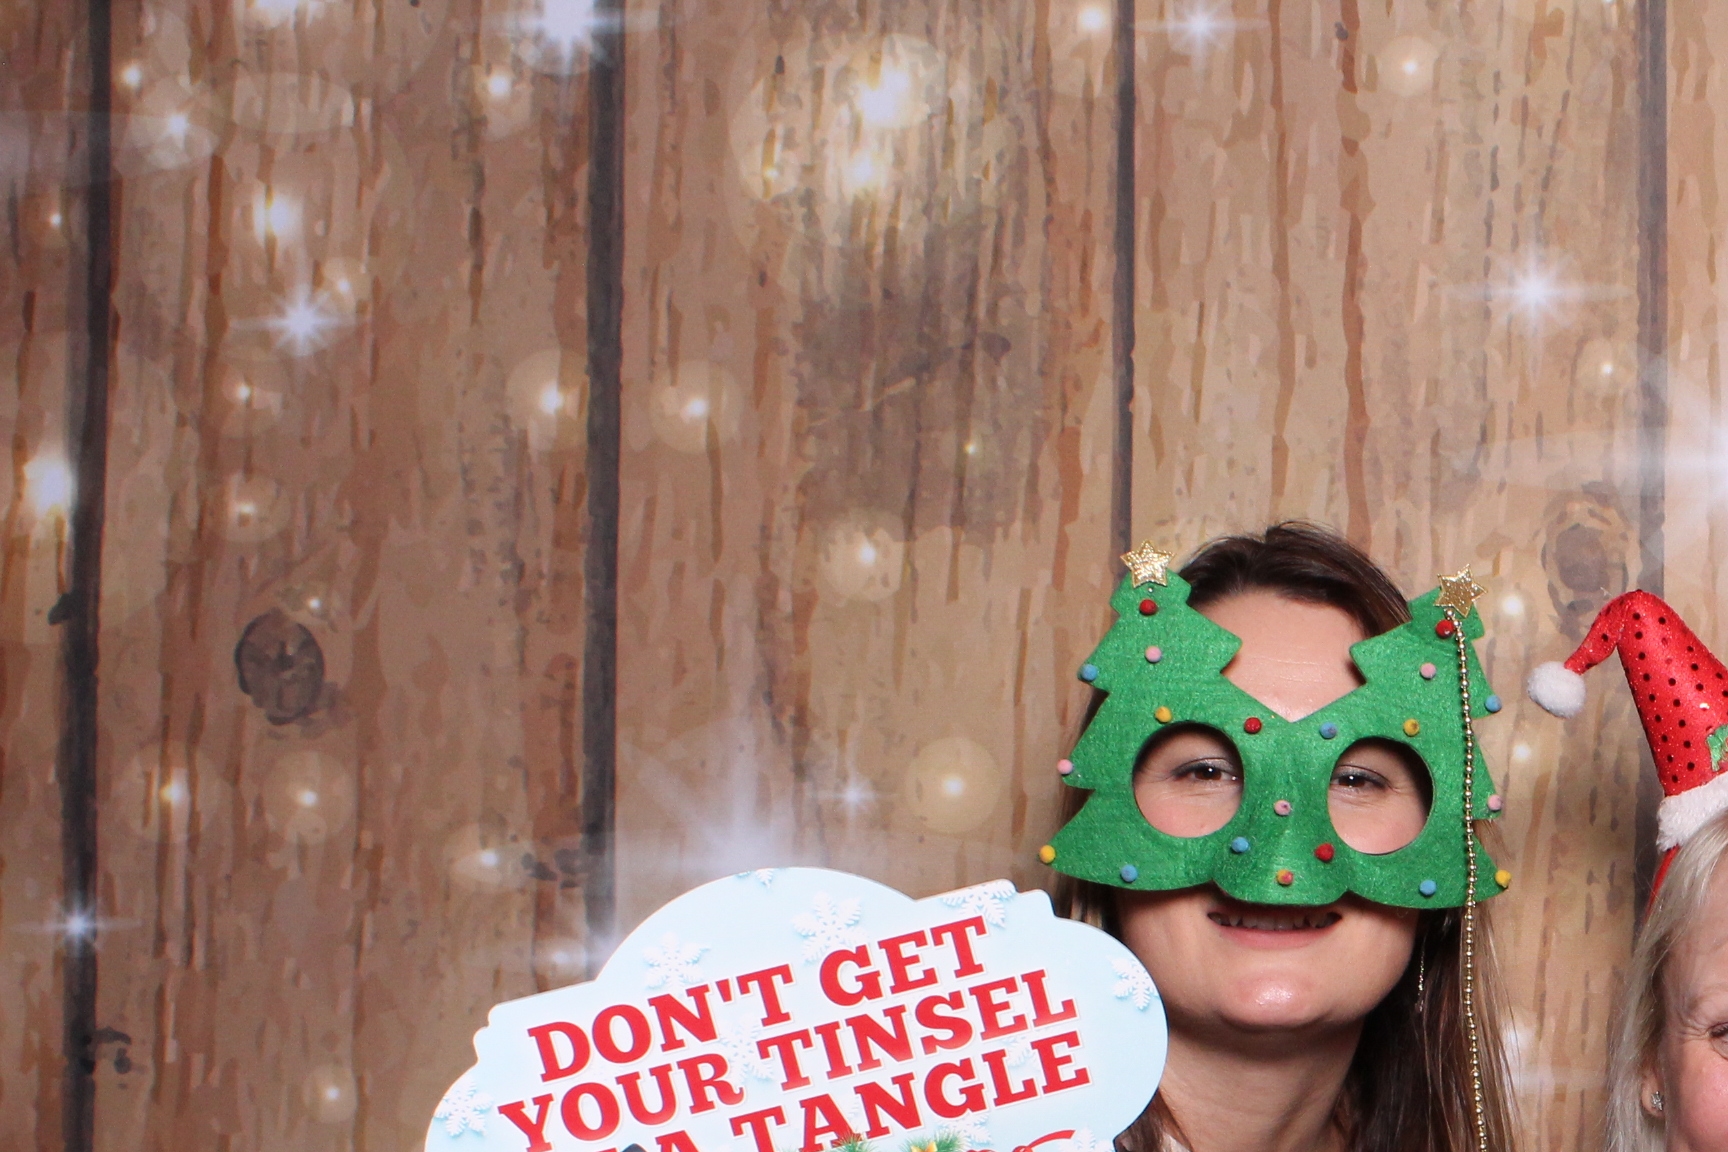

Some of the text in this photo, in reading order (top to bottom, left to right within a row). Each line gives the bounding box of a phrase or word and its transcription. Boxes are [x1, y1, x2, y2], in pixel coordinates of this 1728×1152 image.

[527, 915, 988, 1083] DON'T GET
[758, 968, 1078, 1091] TINSEL
